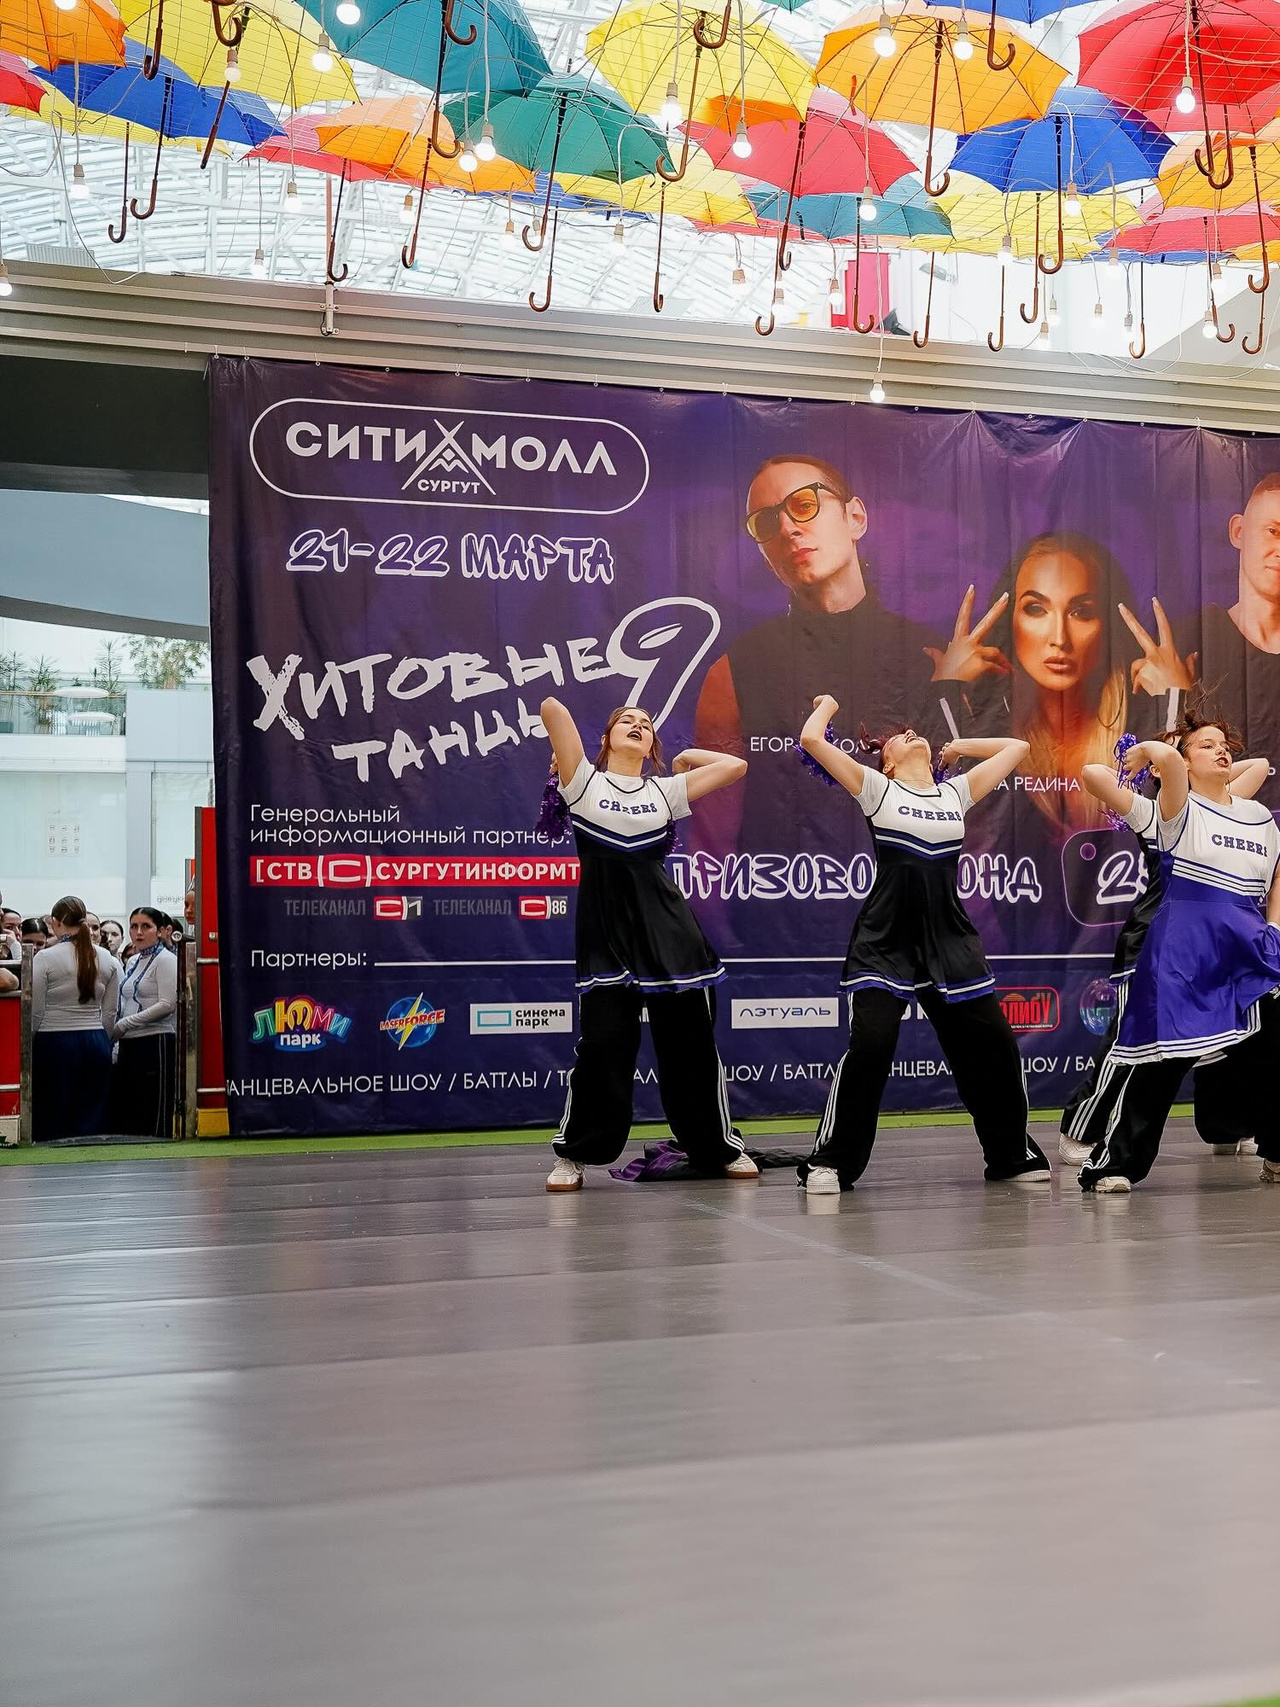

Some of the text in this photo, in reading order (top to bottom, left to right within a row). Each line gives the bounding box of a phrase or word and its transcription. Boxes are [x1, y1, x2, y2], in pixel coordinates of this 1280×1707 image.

[417, 479, 481, 494] СУРГУТ
[286, 528, 615, 584] 21-22 МАРТА
[750, 736, 794, 752] ЕГОР
[1014, 776, 1081, 793] РЕДИНА
[251, 804, 400, 826] Генеральный
[251, 826, 466, 847] информационный
[375, 862, 581, 881] СУРГУТИНФОРМТ
[666, 851, 877, 900] ПРИЗОВО
[957, 853, 1042, 904] ОНД
[284, 899, 366, 916] ТЕЛЕКАНАЛ
[433, 898, 512, 916] ТЕЛЕКАНАЛ
[251, 950, 368, 970] Партнеры:
[379, 1008, 446, 1031] LASERFORCE
[515, 1008, 566, 1018] синема
[515, 1018, 549, 1029] парк
[280, 1033, 322, 1049] парк
[390, 1073, 441, 1093] ШОУ
[463, 1071, 537, 1090] БАТТЛЫ
[783, 1062, 837, 1081] БАТТЛ
